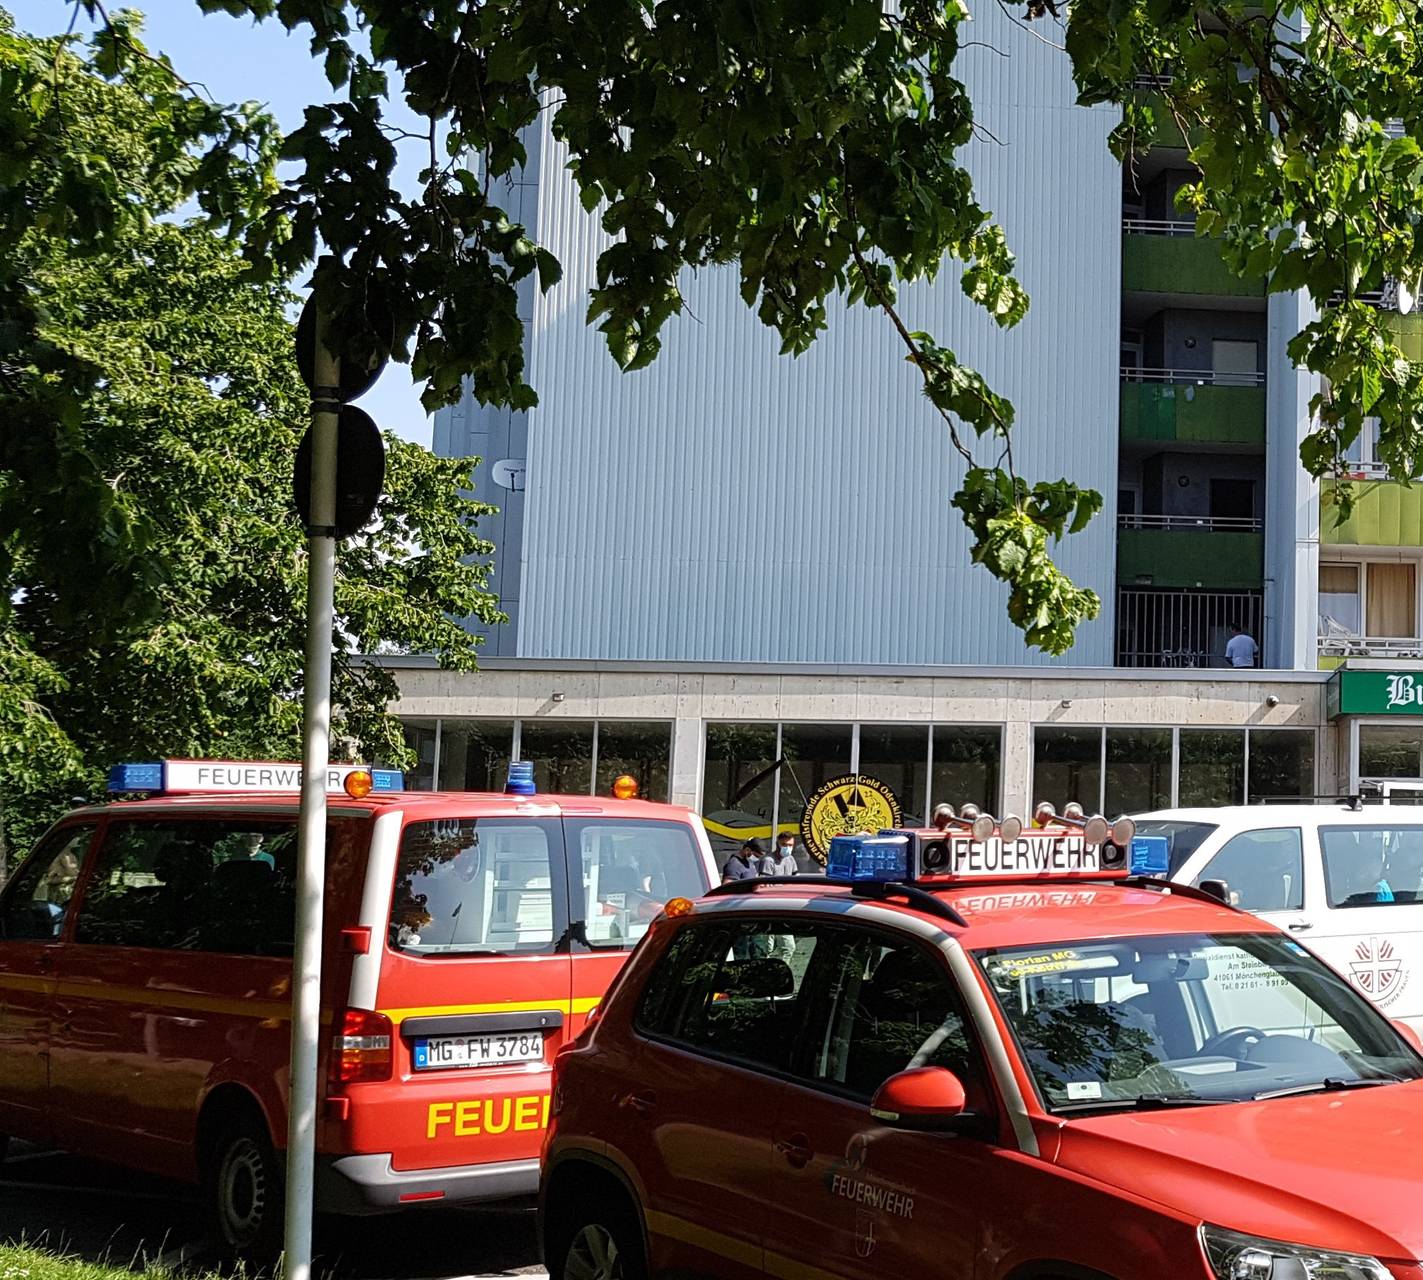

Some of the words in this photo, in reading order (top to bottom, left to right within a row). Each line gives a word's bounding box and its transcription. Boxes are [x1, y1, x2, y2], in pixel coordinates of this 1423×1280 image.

[198, 768, 341, 787] FEUERWER
[880, 785, 903, 828] Odenkirch
[954, 838, 1096, 871] FEUERWEHR
[428, 1040, 453, 1062] MG
[467, 1038, 491, 1060] FW
[496, 1035, 541, 1057] 3784
[427, 1095, 552, 1138] FEUE
[831, 1174, 915, 1219] FEUERWEHR
